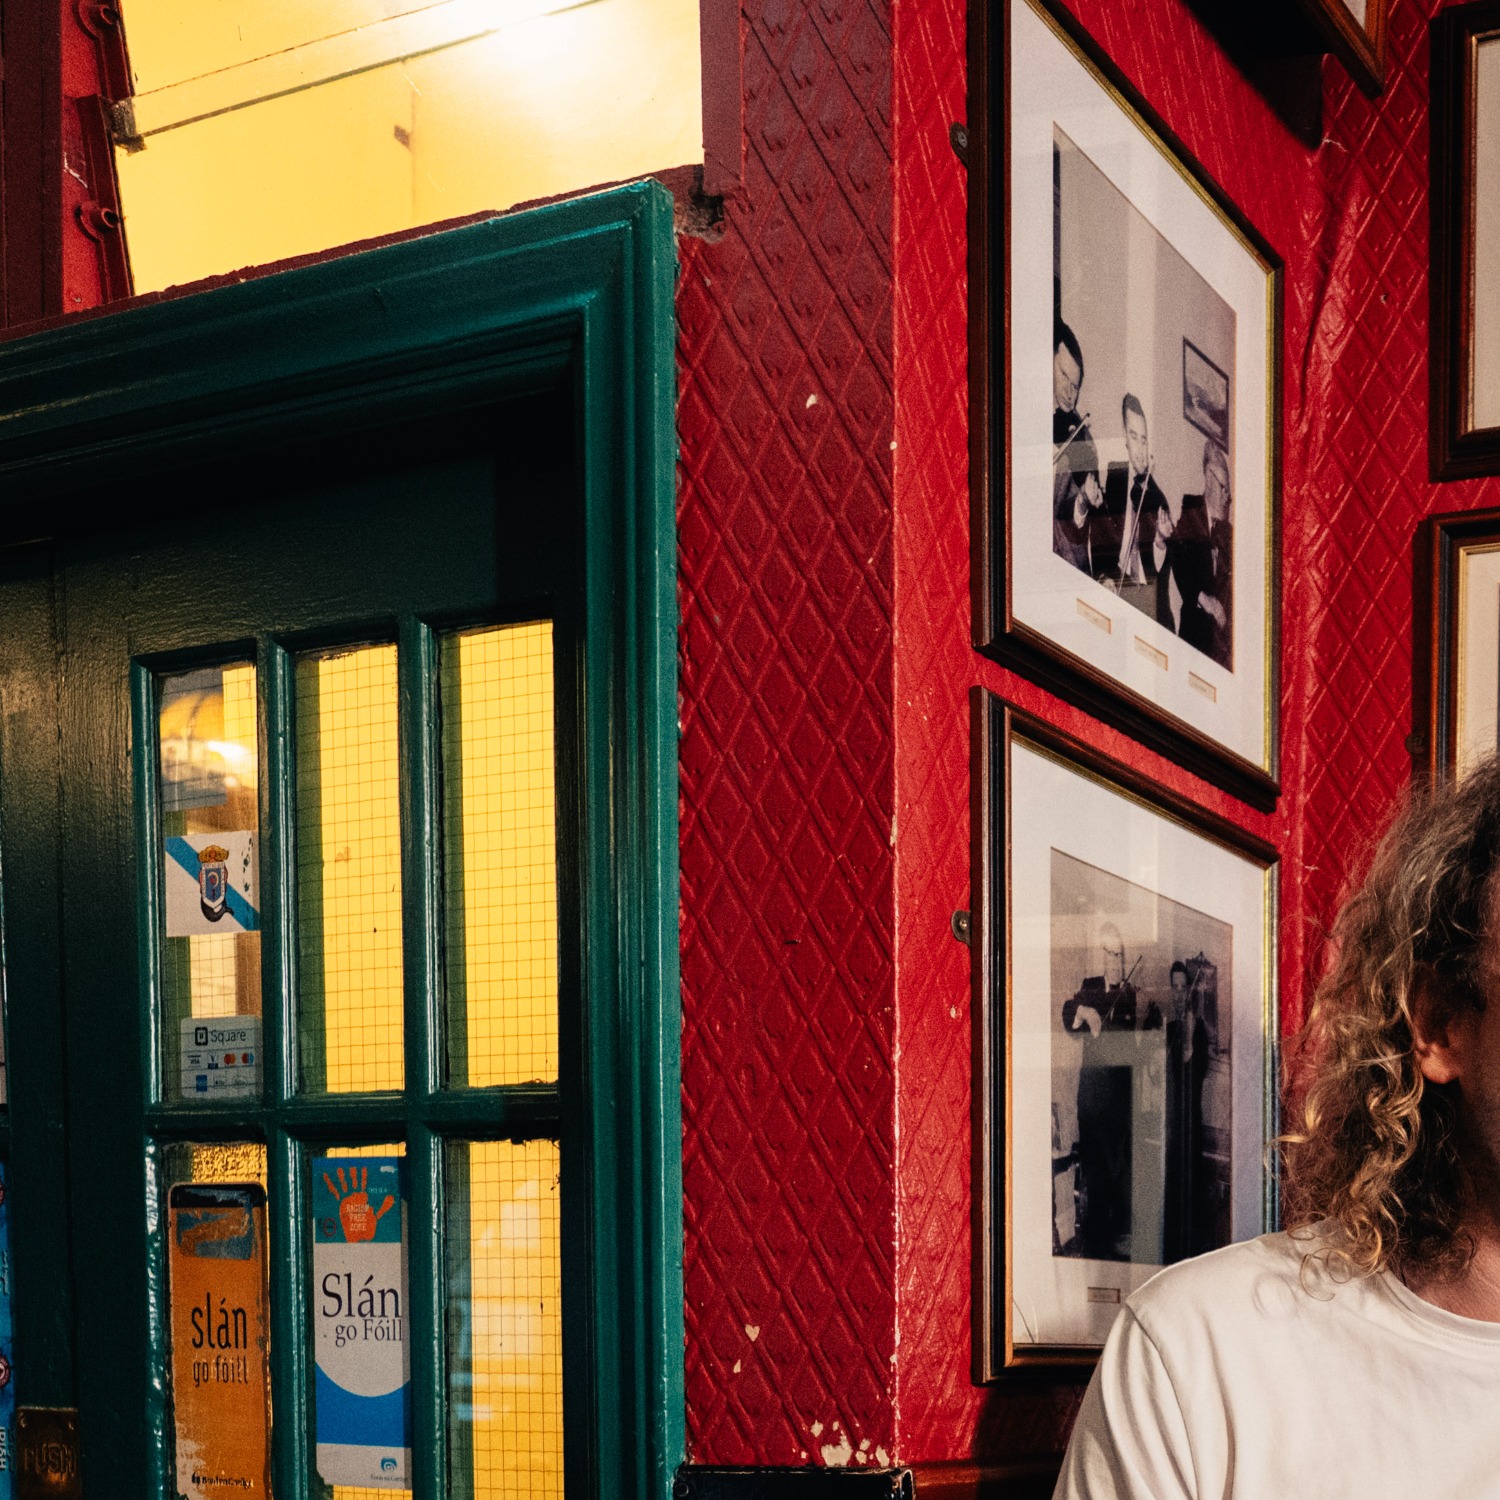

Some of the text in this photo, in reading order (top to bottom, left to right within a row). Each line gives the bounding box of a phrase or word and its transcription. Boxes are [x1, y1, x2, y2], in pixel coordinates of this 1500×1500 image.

[210, 1030, 247, 1045] Square
[322, 1272, 402, 1318] Slán
[191, 1292, 247, 1349] slán
[335, 1318, 403, 1348] go Fóill
[193, 1354, 248, 1388] go fóill
